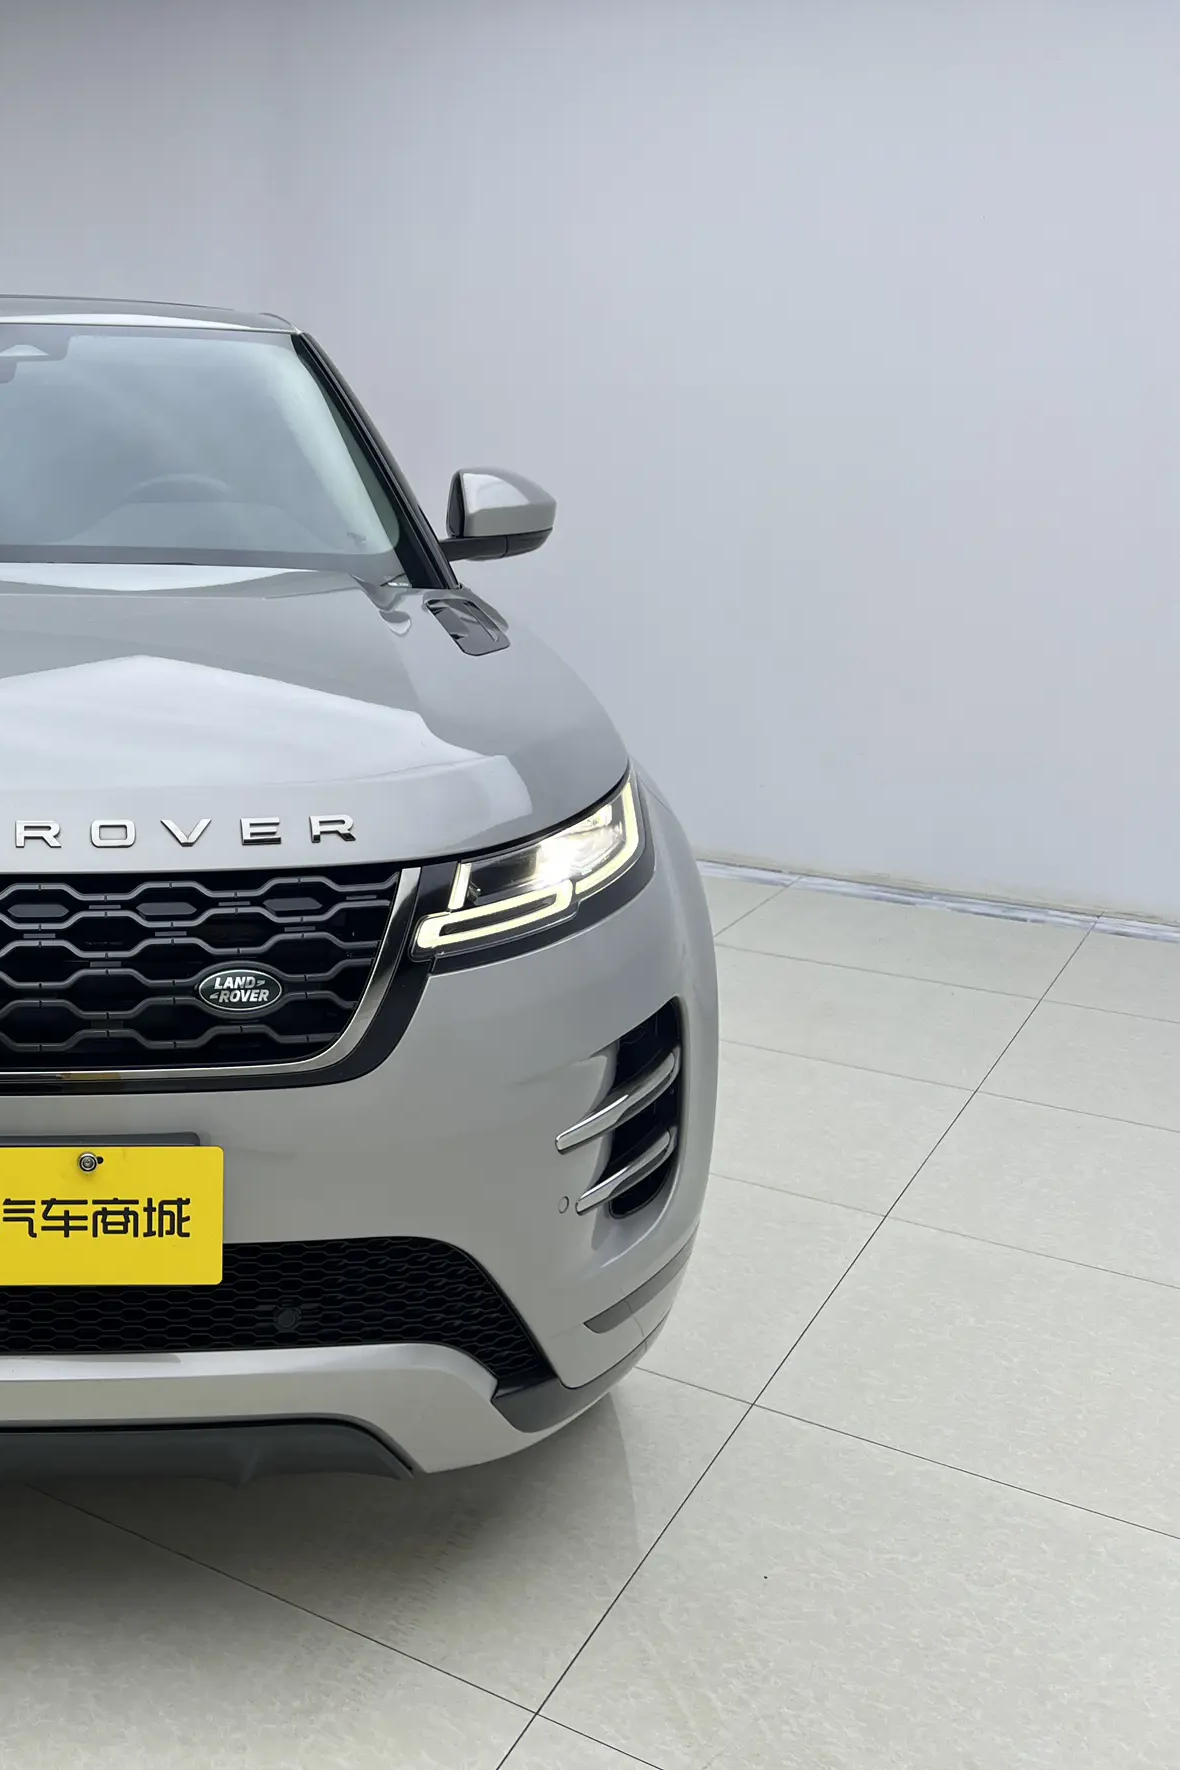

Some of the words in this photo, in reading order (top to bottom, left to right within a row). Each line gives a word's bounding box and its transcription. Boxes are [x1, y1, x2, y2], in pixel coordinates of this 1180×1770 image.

[15, 814, 356, 849] ROVER
[214, 977, 256, 989] LAND
[219, 989, 269, 1002] ROVER
